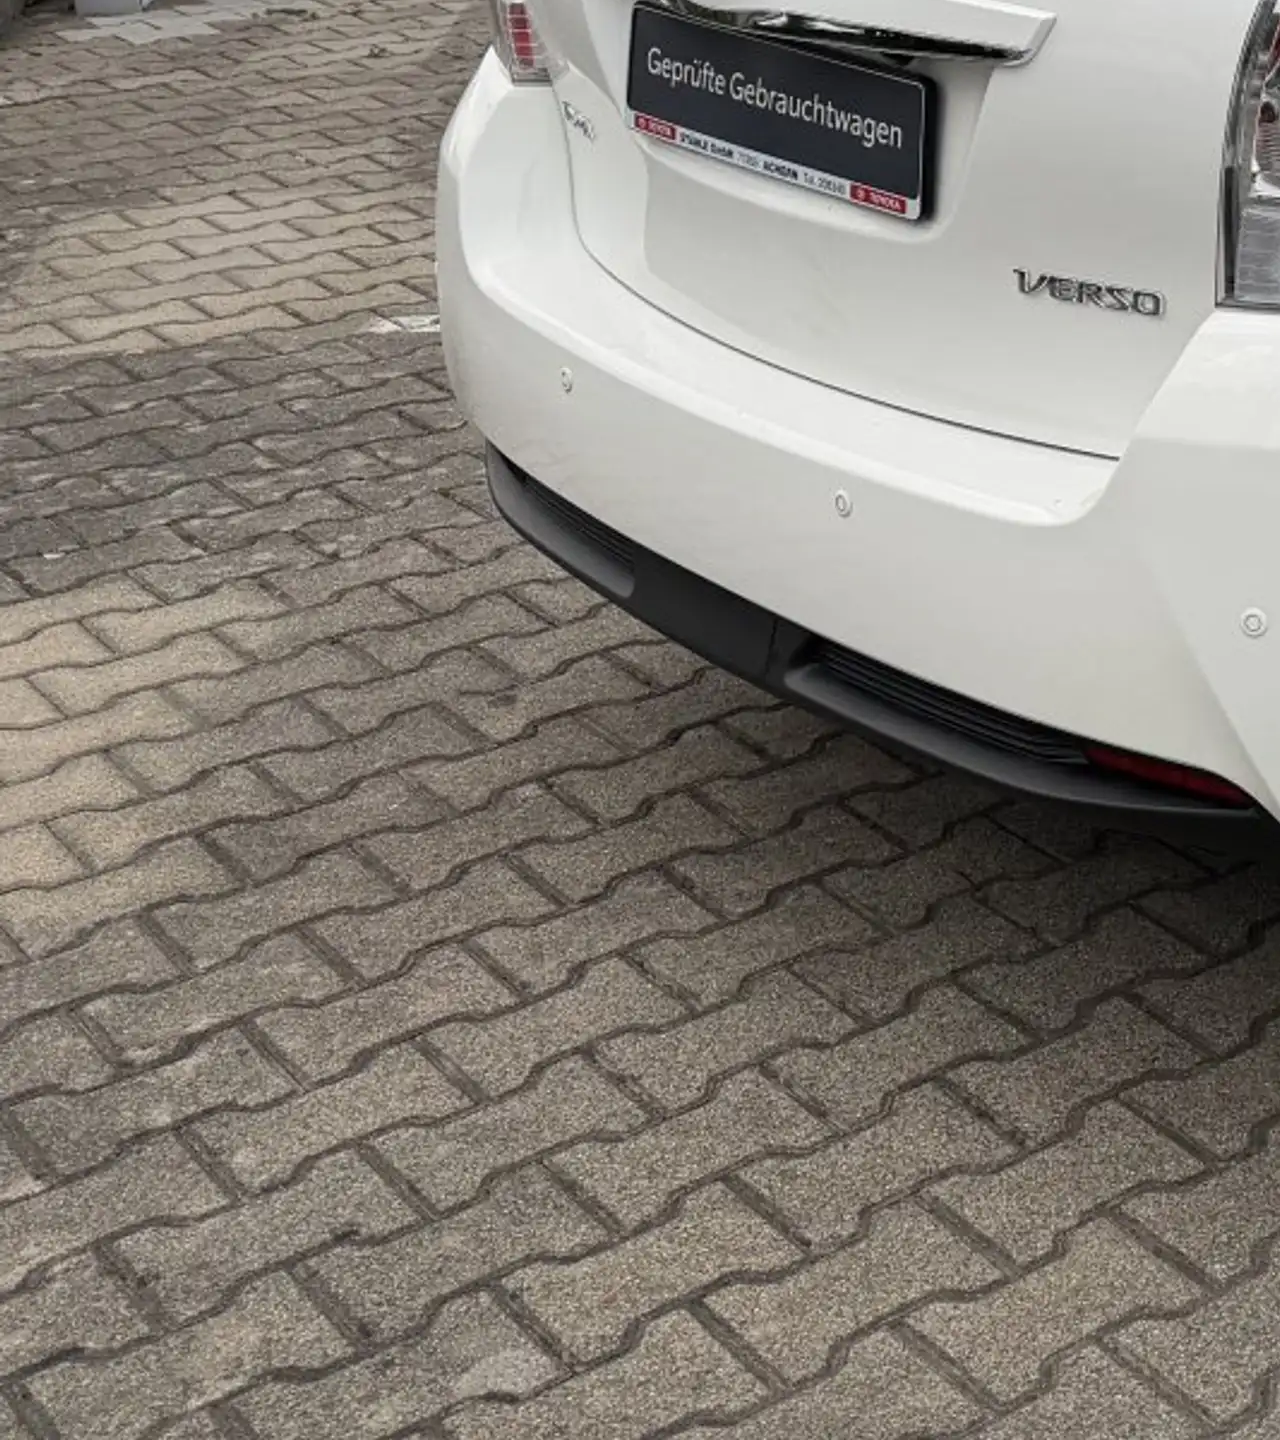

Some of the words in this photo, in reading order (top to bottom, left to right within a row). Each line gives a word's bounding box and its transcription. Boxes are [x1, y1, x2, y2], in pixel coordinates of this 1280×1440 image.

[647, 47, 725, 95] Geprüfte
[729, 71, 903, 149] Gebrauchtwagen
[1012, 267, 1166, 317] VERSO
